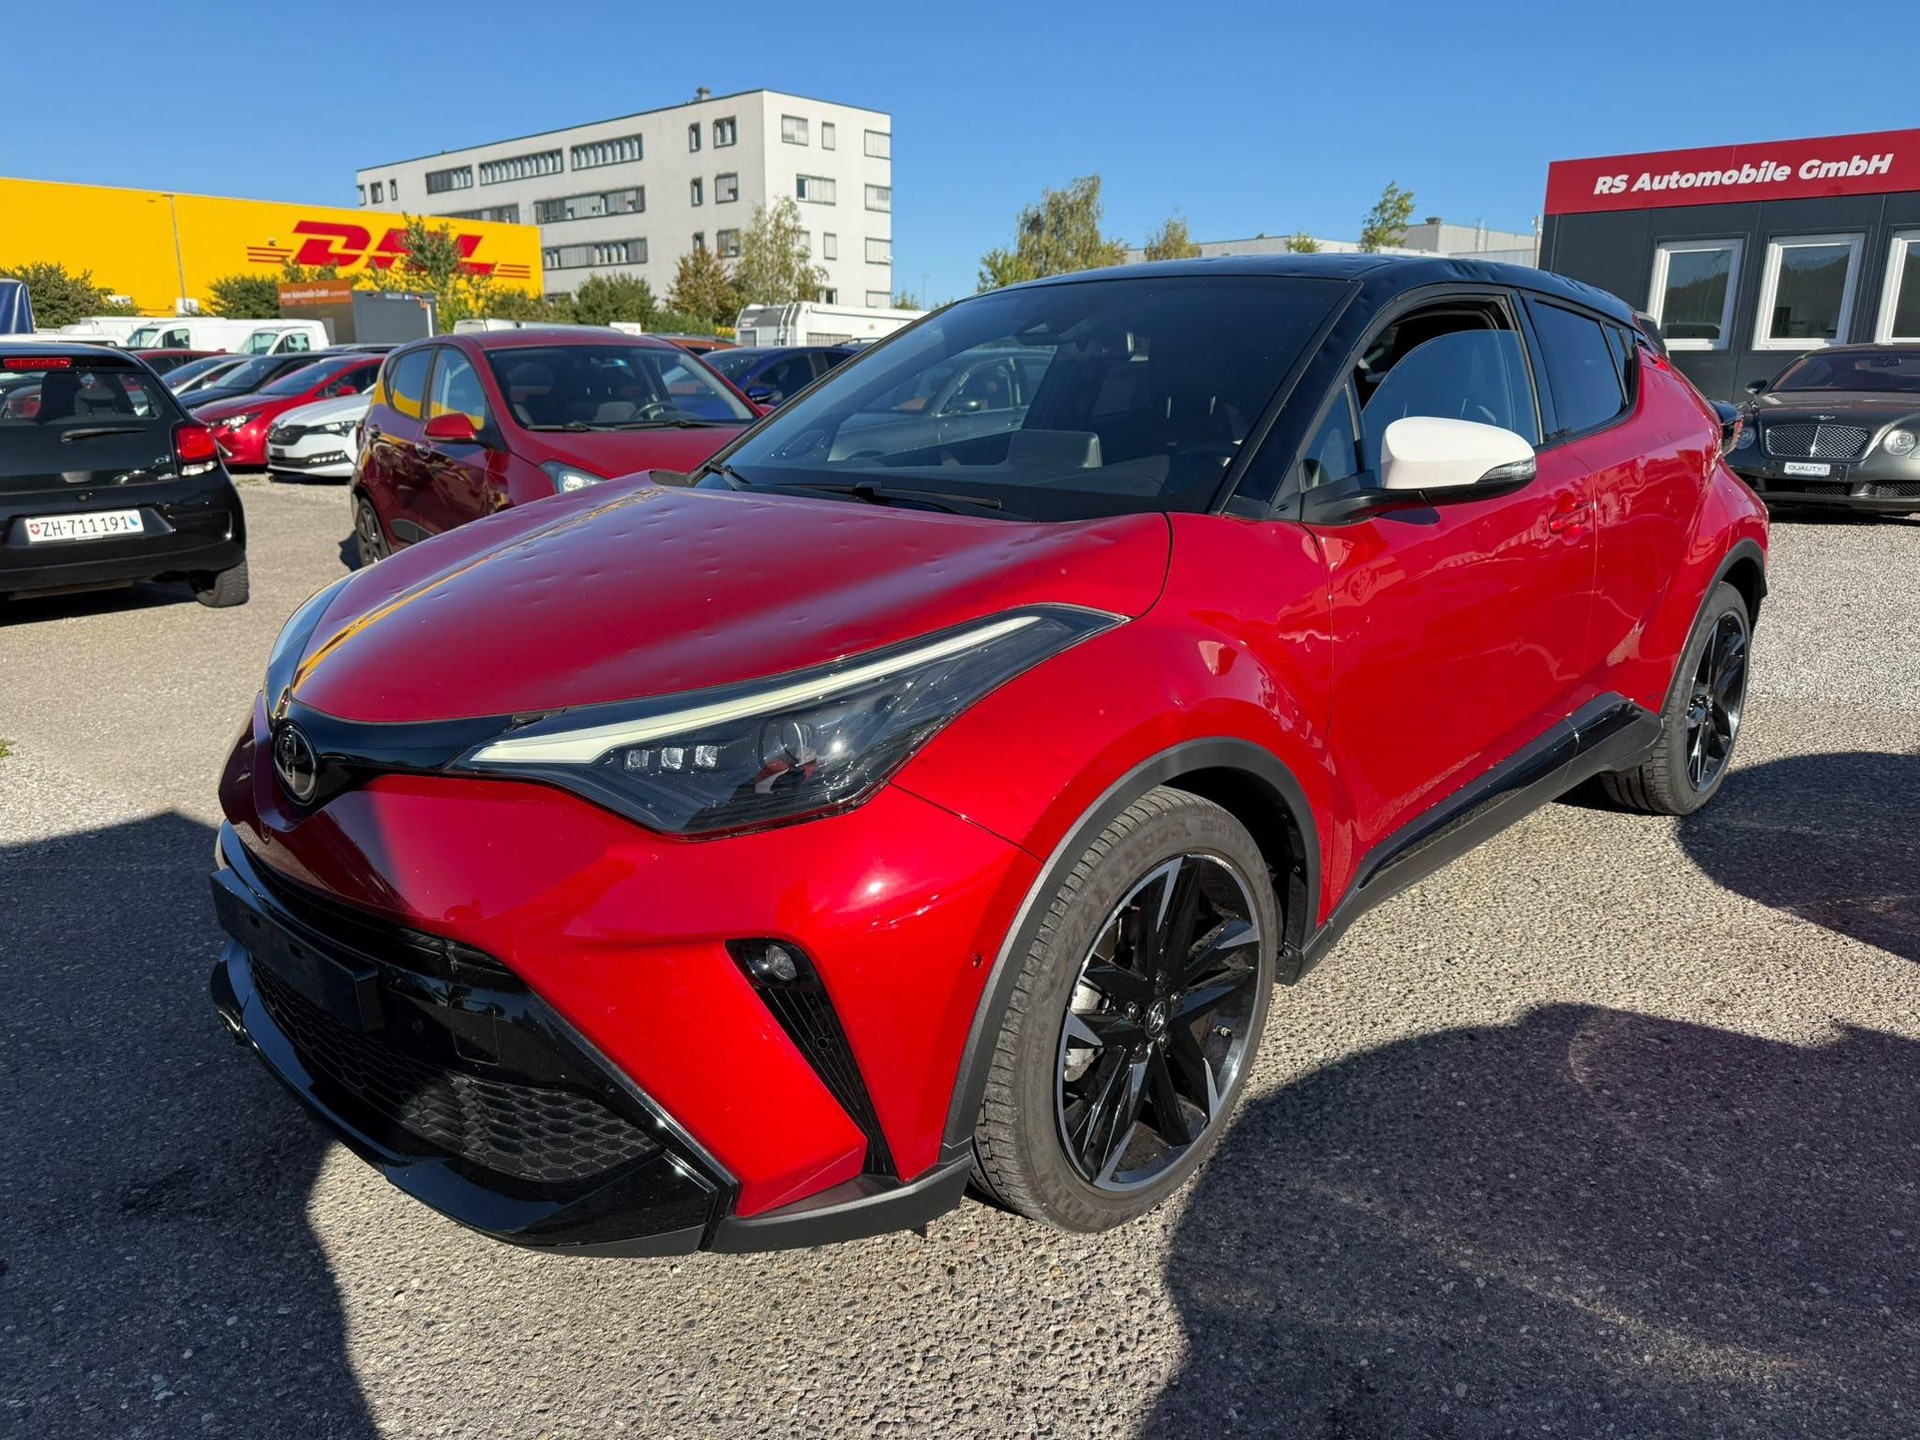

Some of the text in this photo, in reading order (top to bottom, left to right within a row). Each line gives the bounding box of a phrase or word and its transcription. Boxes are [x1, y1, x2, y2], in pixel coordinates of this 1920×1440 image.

[1593, 153, 1894, 195] RS Automobile GmbH
